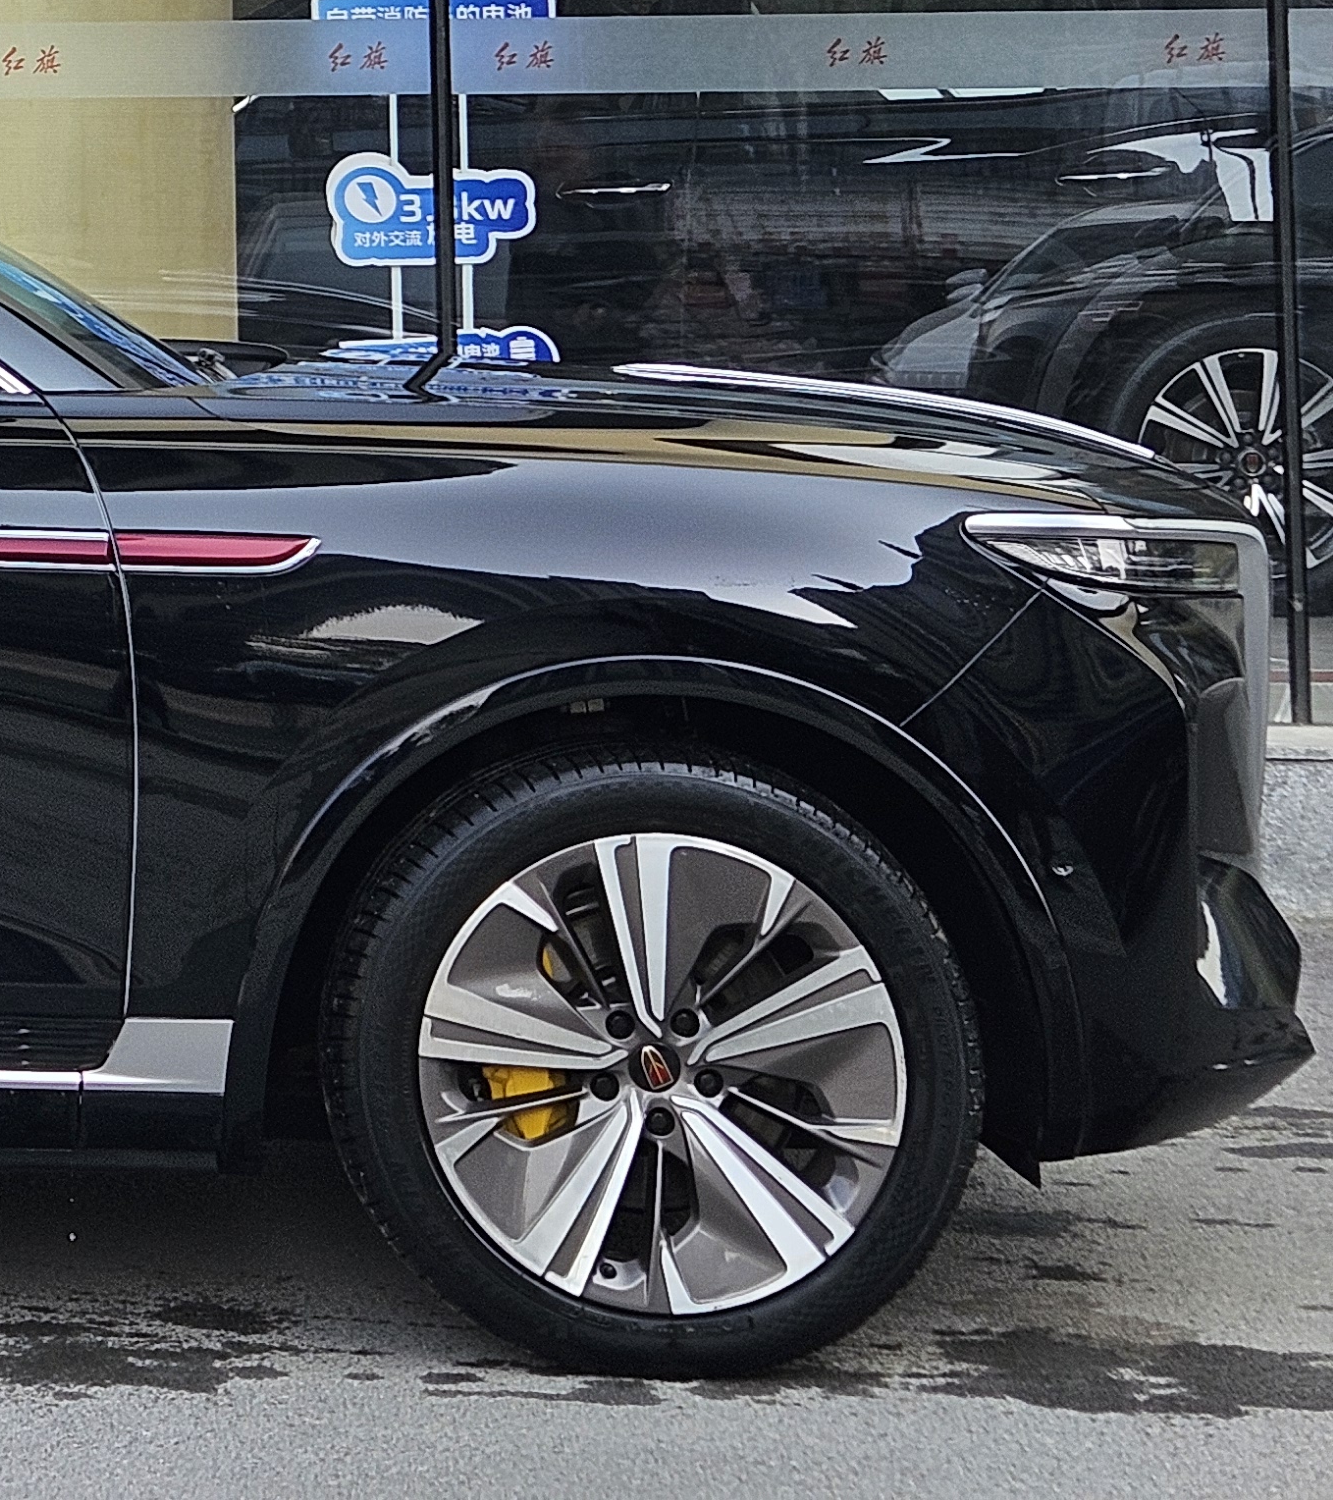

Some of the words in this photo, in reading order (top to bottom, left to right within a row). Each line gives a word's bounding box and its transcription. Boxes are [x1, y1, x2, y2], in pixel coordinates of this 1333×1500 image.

[0, 44, 62, 76] 红旗
[328, 40, 389, 72] 红旗
[494, 39, 555, 71] 红旗
[826, 35, 888, 68] 红旗
[1164, 32, 1227, 65] 红旗
[399, 192, 515, 223] 3.kw
